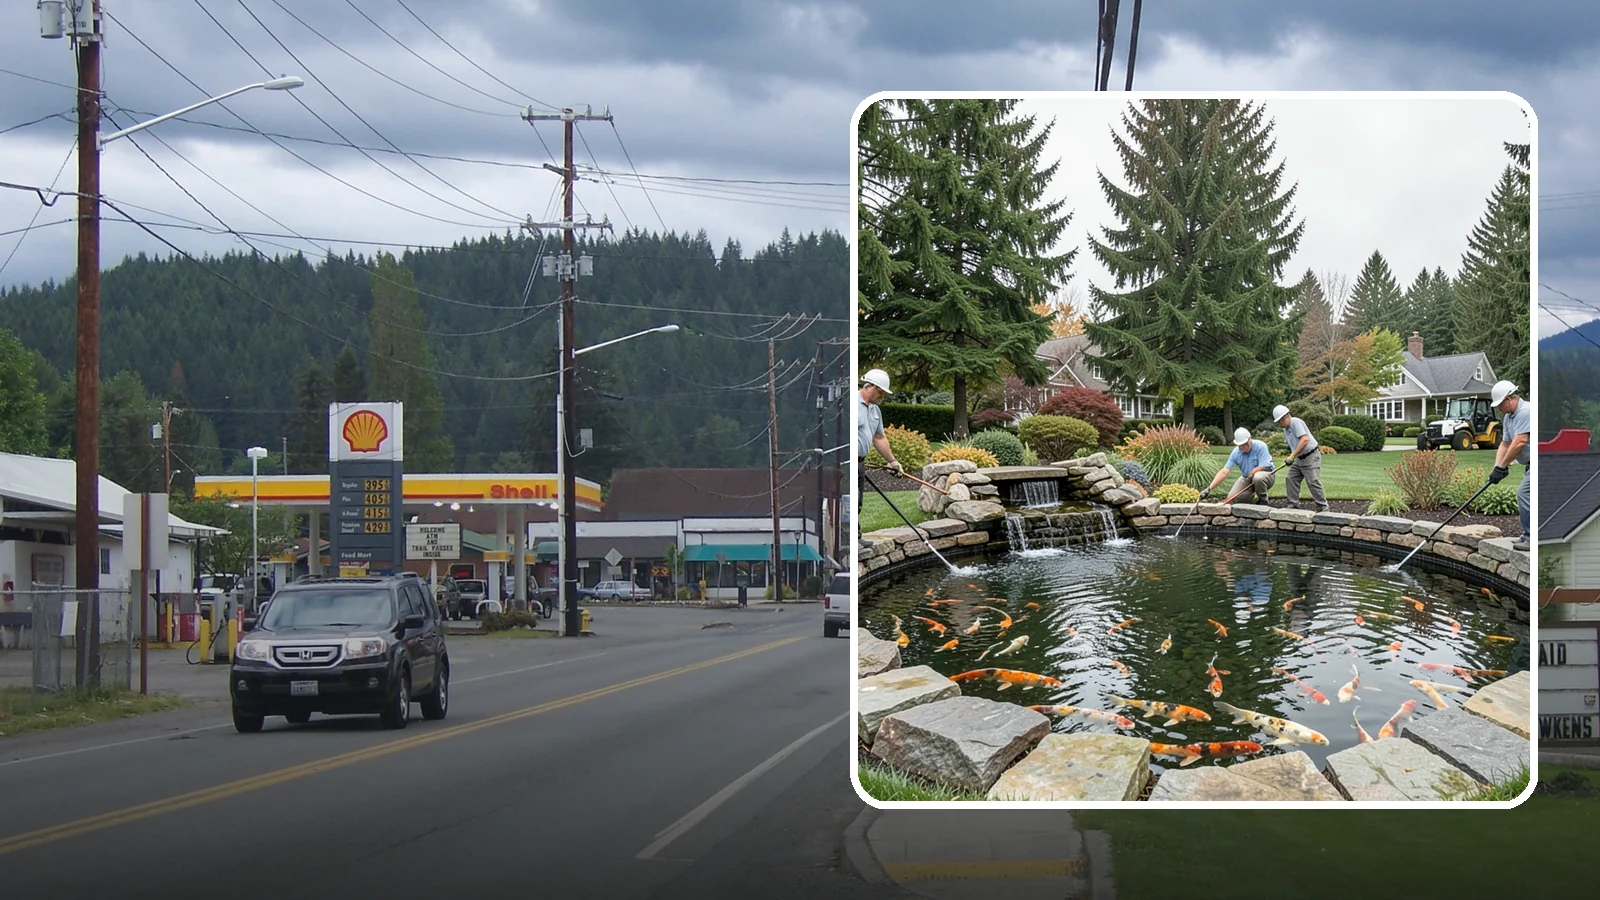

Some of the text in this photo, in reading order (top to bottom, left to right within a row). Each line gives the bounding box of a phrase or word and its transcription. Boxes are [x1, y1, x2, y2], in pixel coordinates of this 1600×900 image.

[366, 480, 384, 490] 395
[490, 484, 547, 499] Shell
[366, 494, 384, 504] 405
[366, 508, 384, 518] 415
[366, 522, 384, 533] 429
